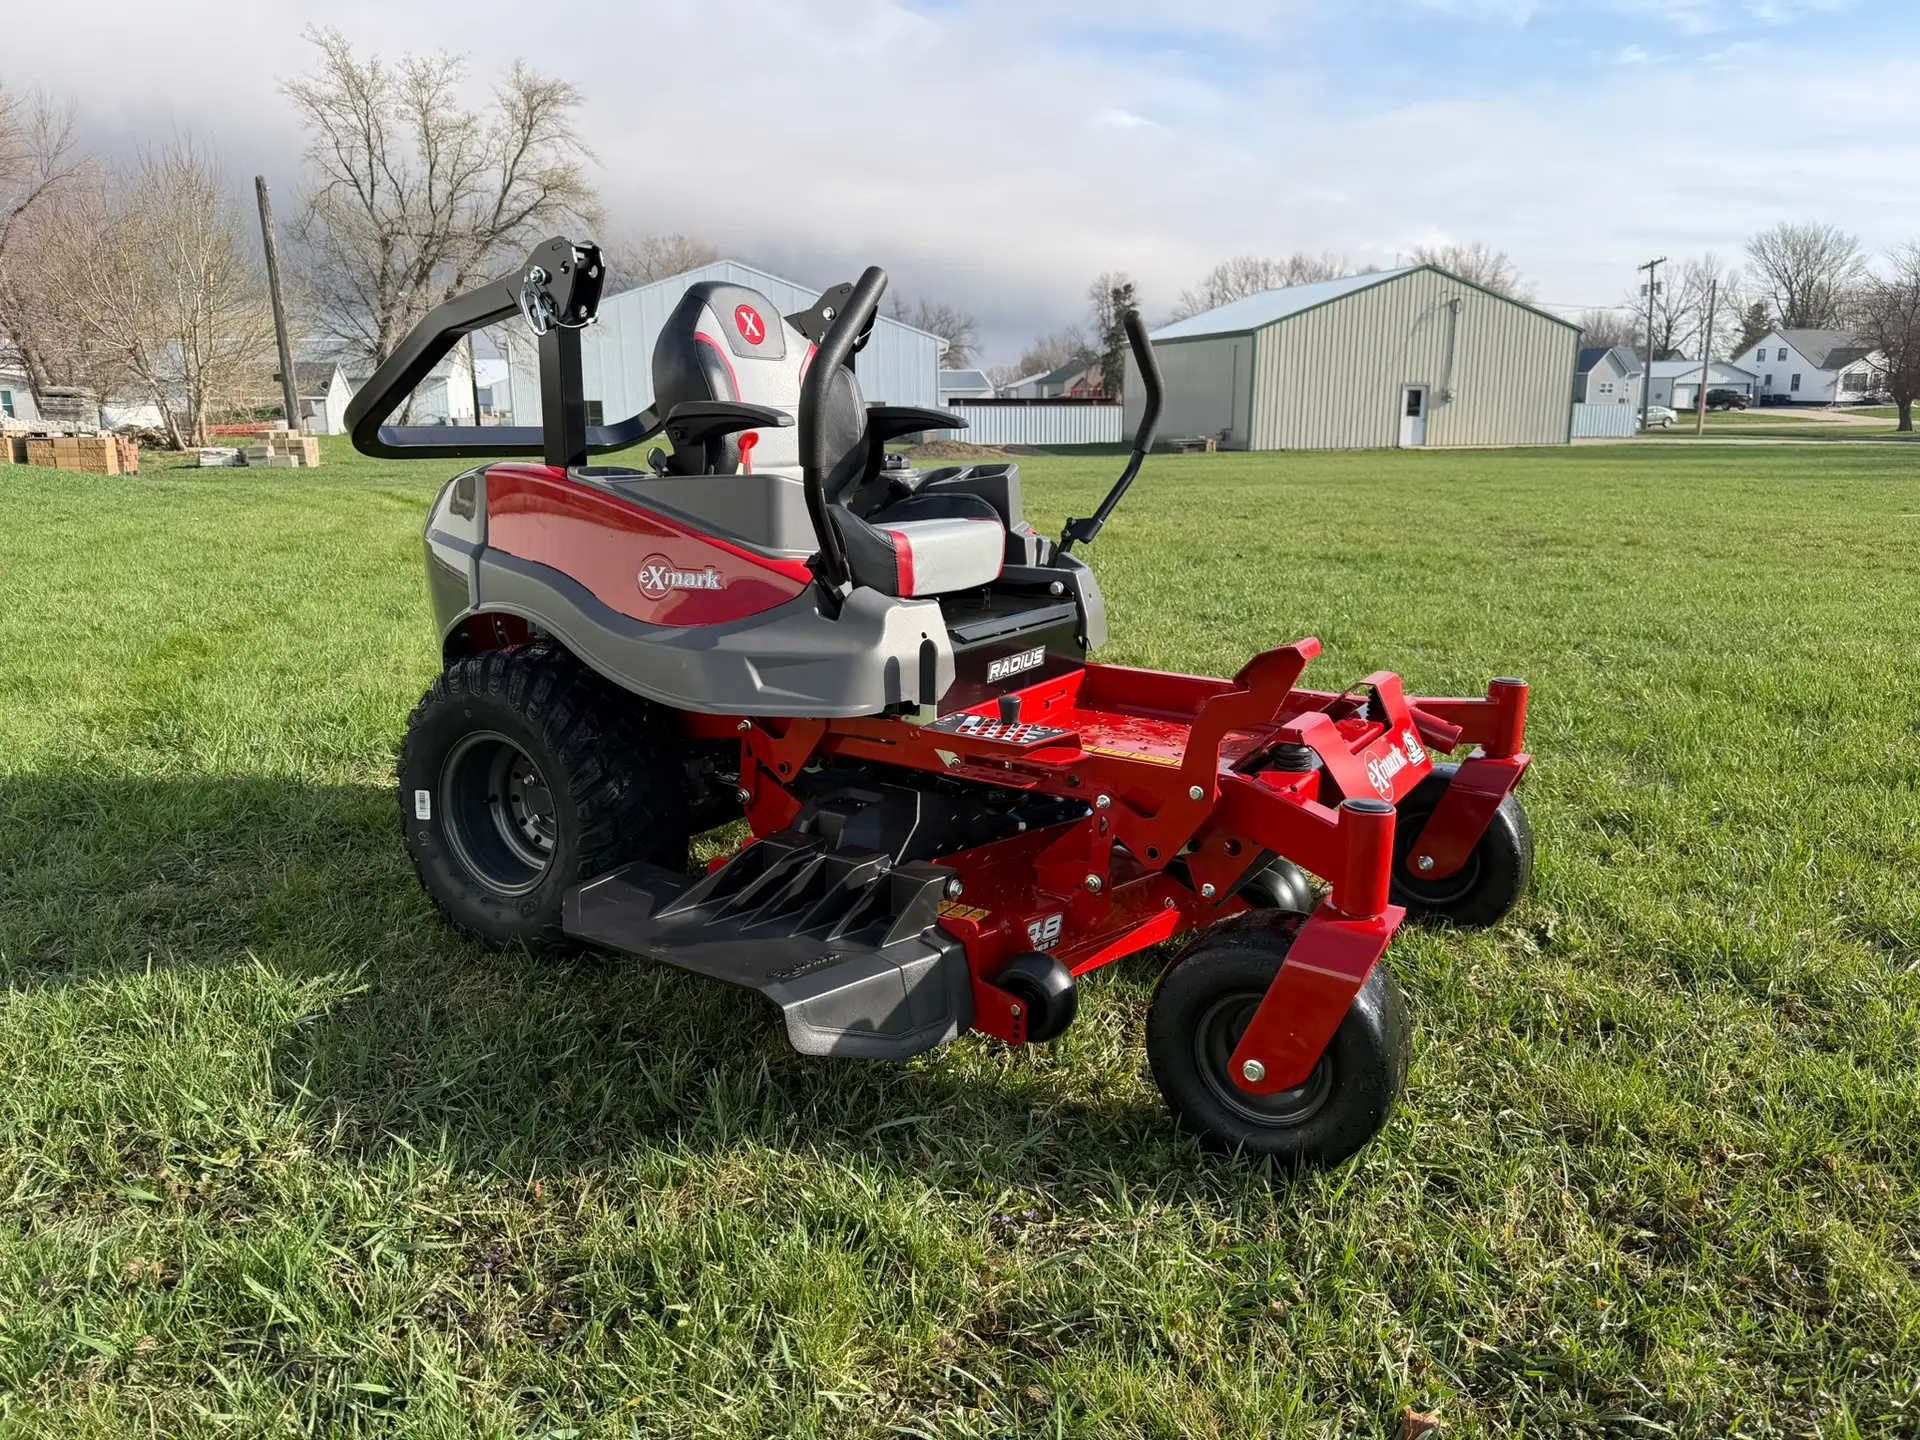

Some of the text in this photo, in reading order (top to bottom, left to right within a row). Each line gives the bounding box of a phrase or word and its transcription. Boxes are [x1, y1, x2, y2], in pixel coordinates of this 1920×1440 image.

[740, 311, 761, 337] X
[639, 564, 722, 590] eXmark
[988, 647, 1045, 682] RADIUS
